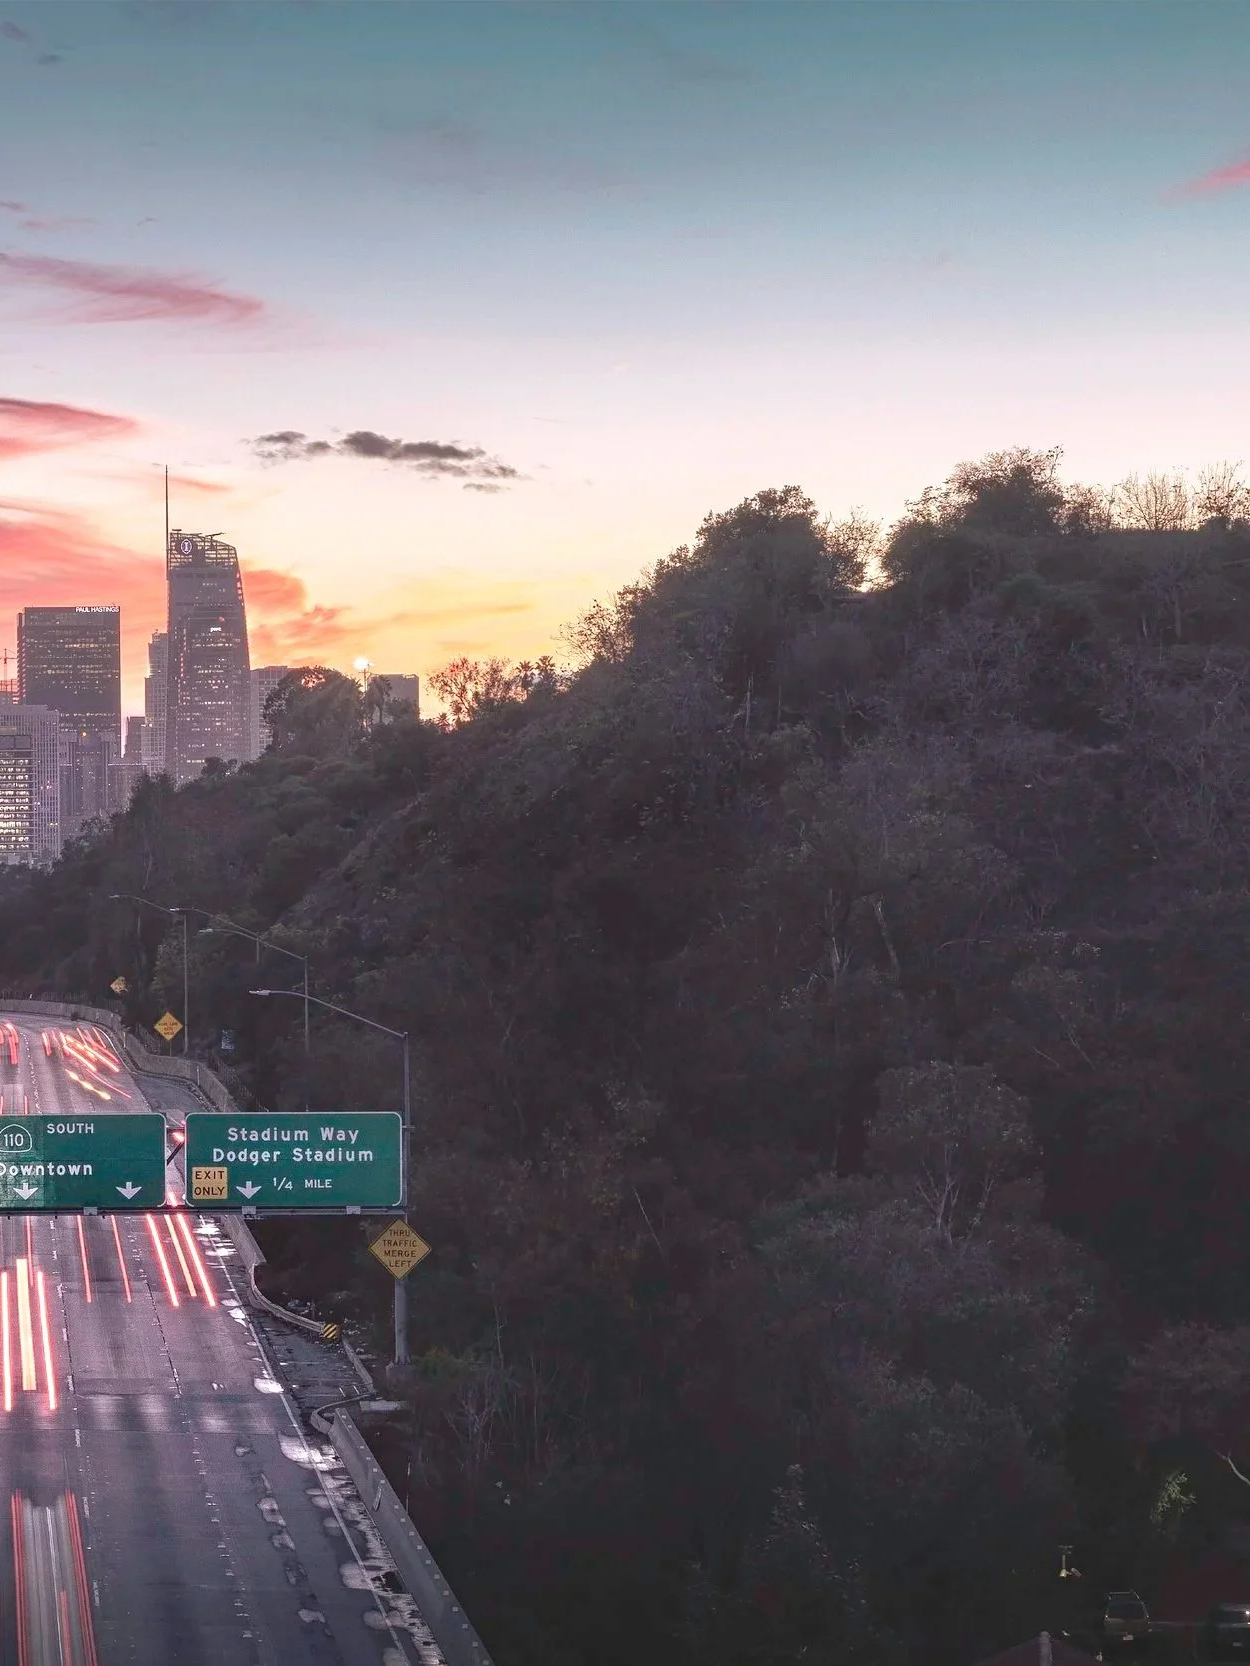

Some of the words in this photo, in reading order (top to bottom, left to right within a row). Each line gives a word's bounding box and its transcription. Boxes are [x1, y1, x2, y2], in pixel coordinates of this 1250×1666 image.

[46, 1123, 95, 1134] SOUTH
[3, 1133, 24, 1147] 110
[227, 1127, 309, 1142] Stadium
[320, 1127, 359, 1144] Way
[212, 1148, 282, 1166] Dodger
[292, 1147, 374, 1162] Stadium
[195, 1170, 225, 1180] EXIT
[305, 1179, 332, 1189] MILE
[194, 1186, 225, 1196] ONLY
[382, 1239, 418, 1247] TRAFFIC
[383, 1250, 417, 1258] MERGE
[389, 1260, 412, 1268] LEFT
